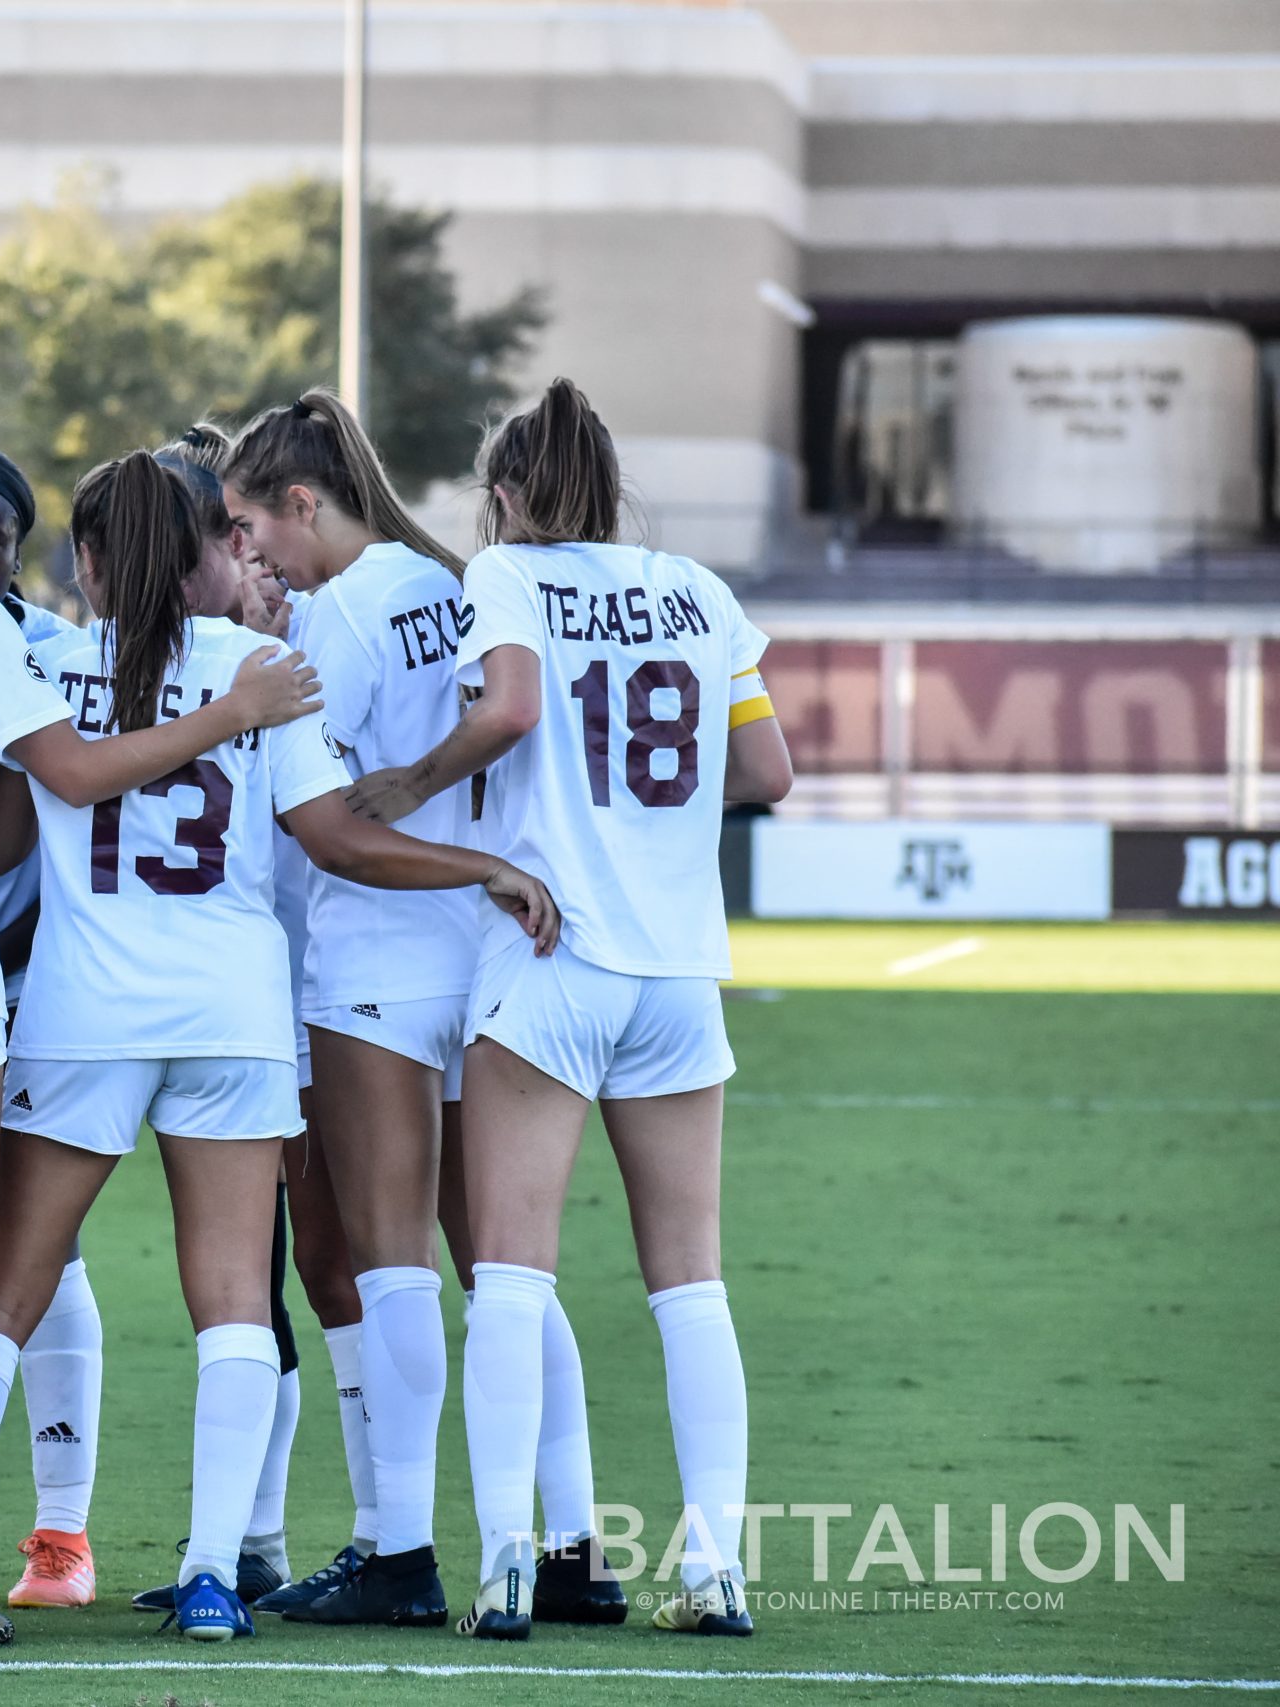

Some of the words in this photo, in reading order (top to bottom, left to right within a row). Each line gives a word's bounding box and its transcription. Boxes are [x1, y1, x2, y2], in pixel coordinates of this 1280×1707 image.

[538, 582, 653, 646] TEXAS
[59, 671, 184, 735] TES
[571, 660, 700, 808] 18
[90, 760, 234, 895] 13
[1178, 836, 1280, 909] AG
[351, 1005, 381, 1020] adidas
[36, 1434, 81, 1444] adidas
[190, 1608, 222, 1618] COPA
